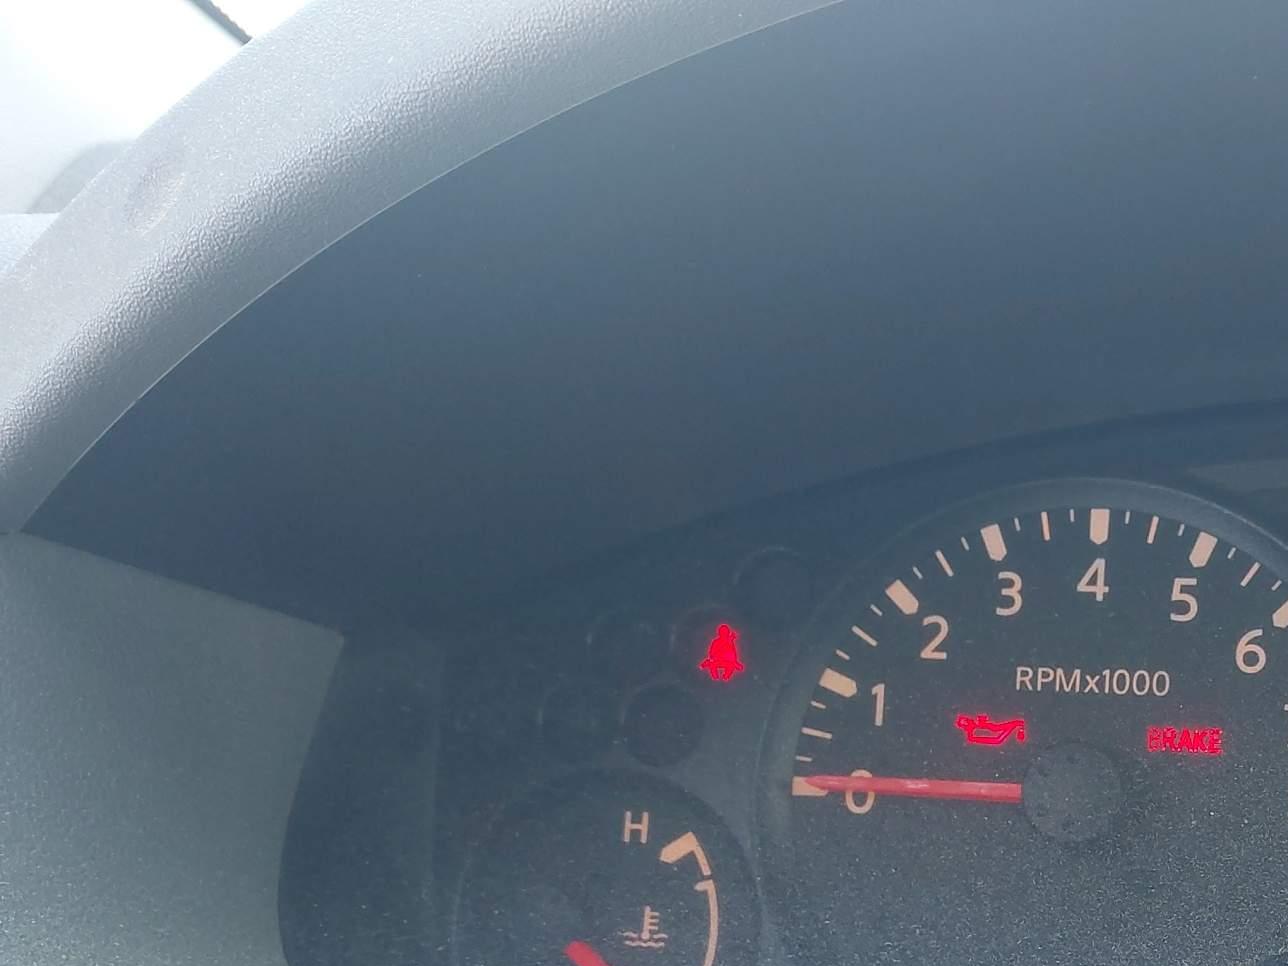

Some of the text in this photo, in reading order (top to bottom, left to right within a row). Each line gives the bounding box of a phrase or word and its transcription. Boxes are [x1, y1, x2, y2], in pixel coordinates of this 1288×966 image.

[996, 571, 1023, 616] 3
[1076, 558, 1110, 602] 4
[1170, 577, 1198, 622] 5
[919, 614, 948, 660] 2
[1235, 629, 1266, 674] 6
[1016, 666, 1170, 697] RPMx1000
[871, 683, 885, 727] 1
[1146, 726, 1224, 755] BRAKE
[845, 769, 876, 814] 0
[623, 811, 649, 844] H
